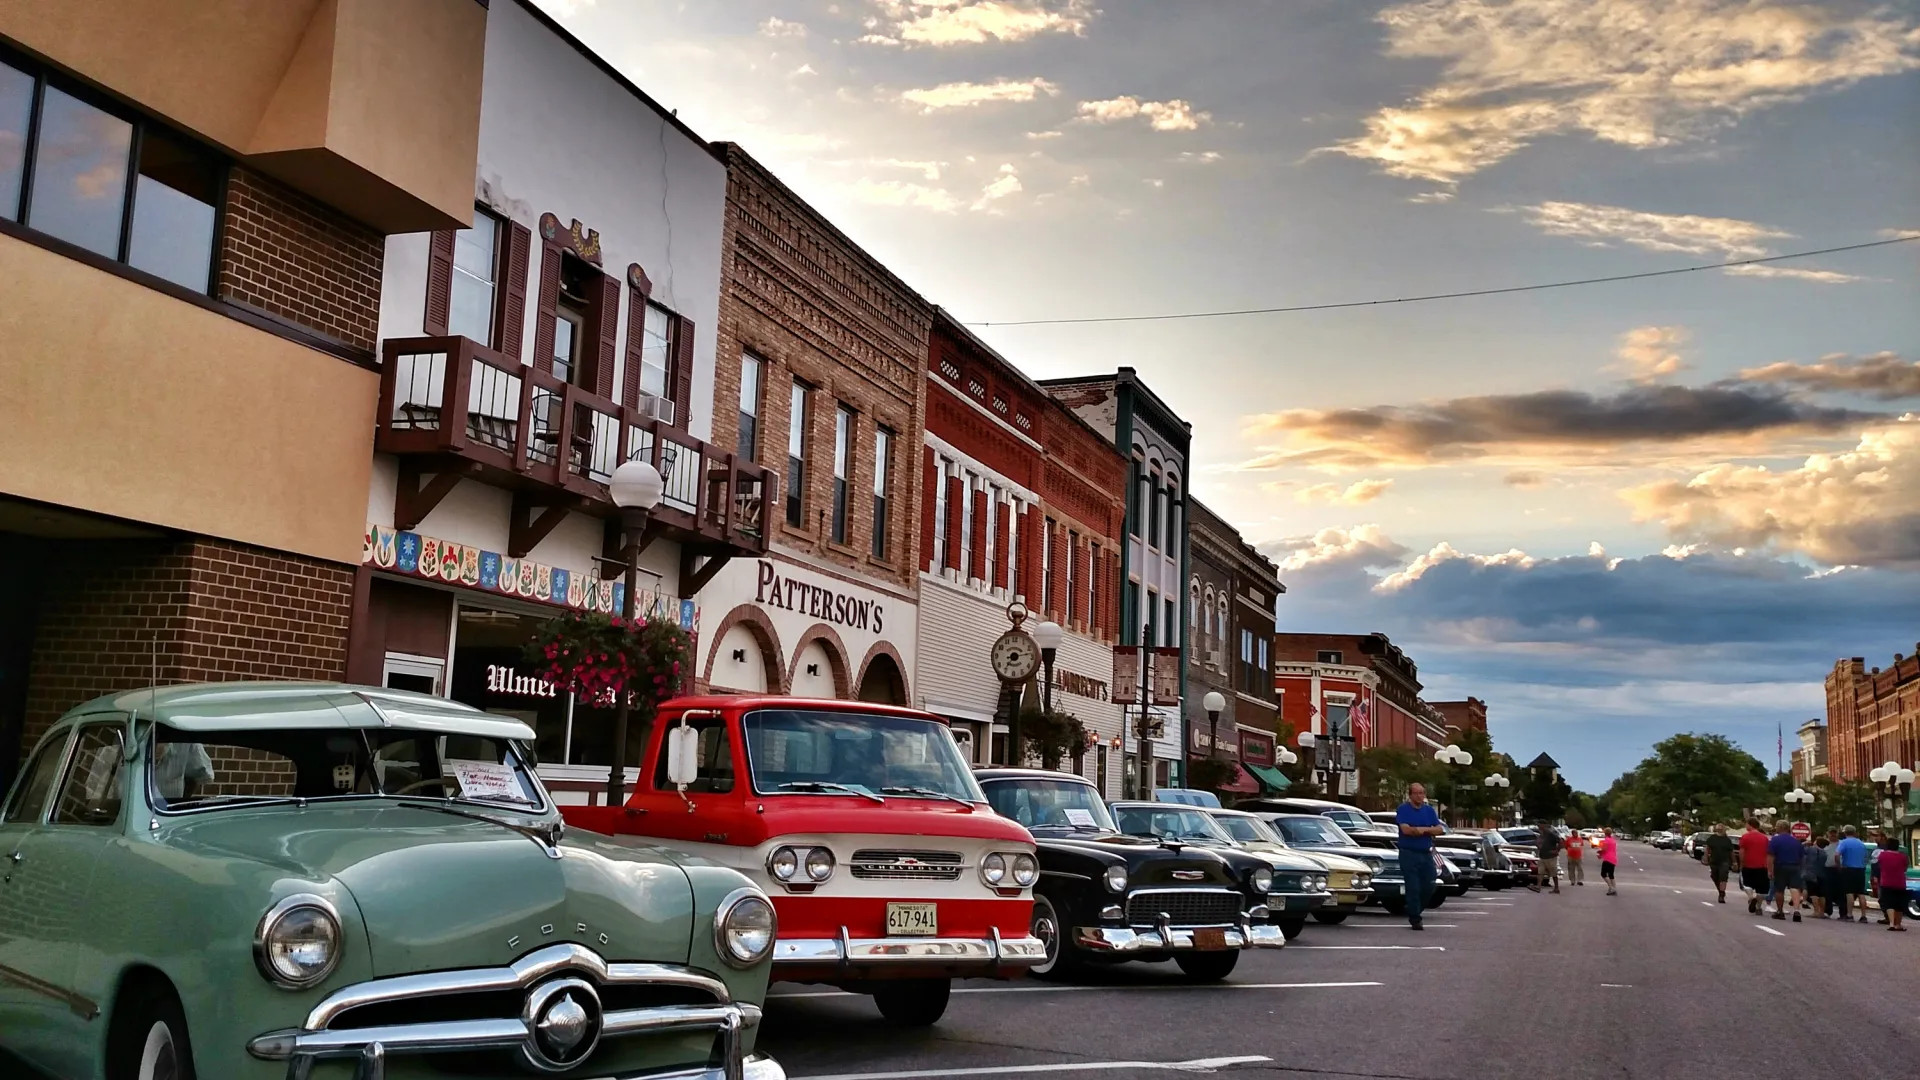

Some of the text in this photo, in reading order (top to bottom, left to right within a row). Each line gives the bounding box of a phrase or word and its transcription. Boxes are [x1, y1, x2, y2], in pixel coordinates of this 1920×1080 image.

[755, 559, 883, 634] PATTERSON'S
[1055, 668, 1108, 702] AMBRECHT'S
[507, 922, 609, 949] FORD
